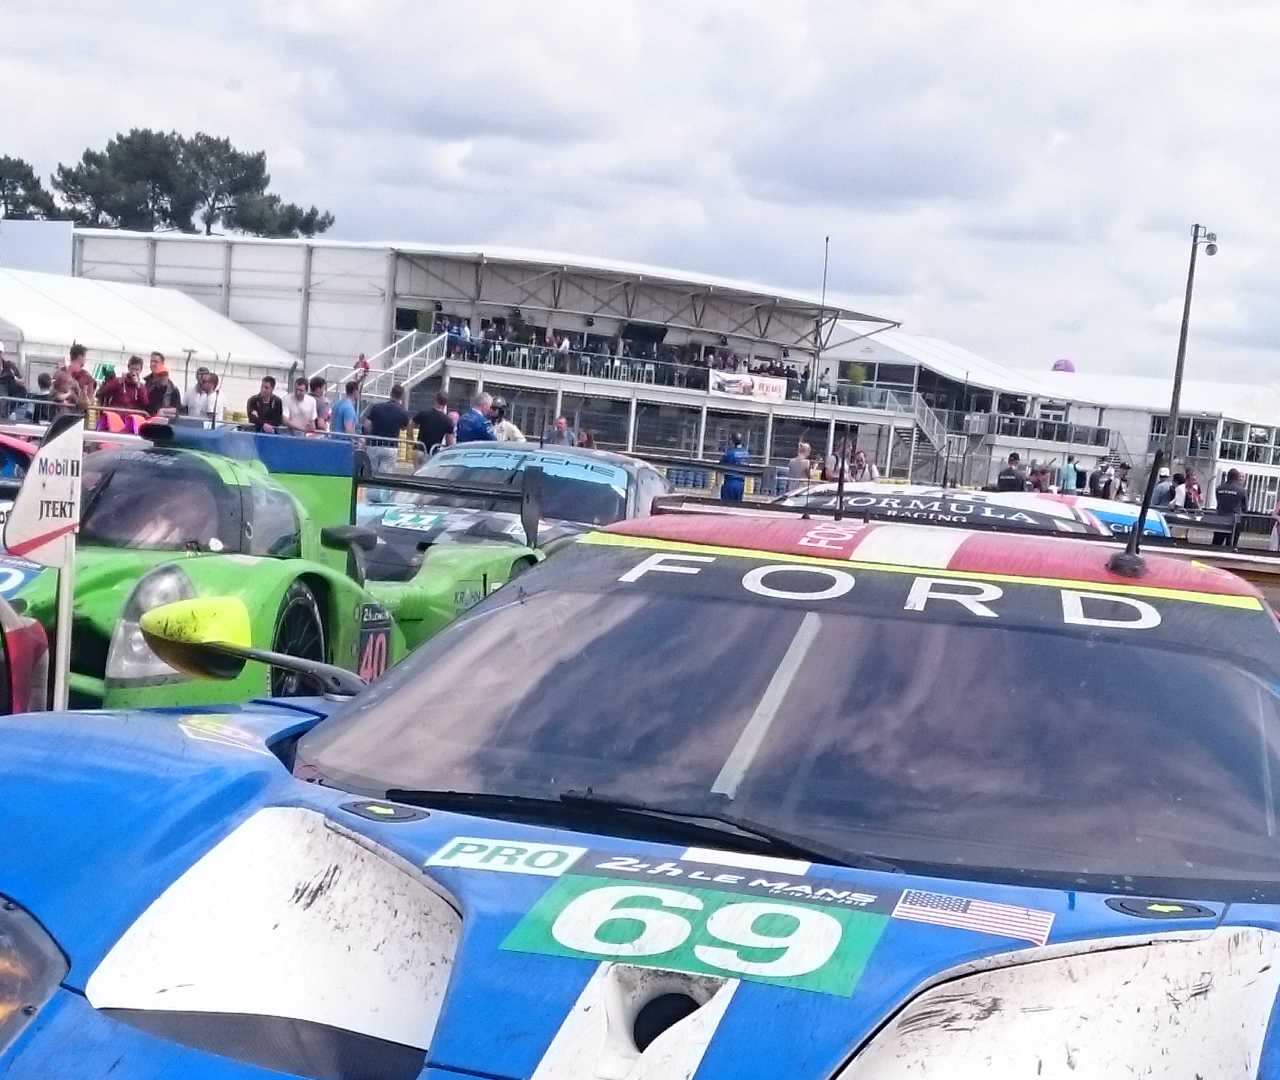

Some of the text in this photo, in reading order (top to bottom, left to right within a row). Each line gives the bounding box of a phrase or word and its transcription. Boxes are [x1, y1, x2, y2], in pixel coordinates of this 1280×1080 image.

[38, 458, 80, 477] Mobil 1
[439, 452, 615, 478] PORSCHE
[39, 500, 75, 520] JTEKT
[823, 496, 1039, 525] FORMULA
[886, 510, 968, 523] RACING
[618, 552, 1163, 630] FORD
[360, 632, 387, 681] 40
[443, 840, 568, 872] PRO
[688, 871, 746, 885] LE
[748, 878, 879, 904] MANS
[551, 885, 843, 978] 69
